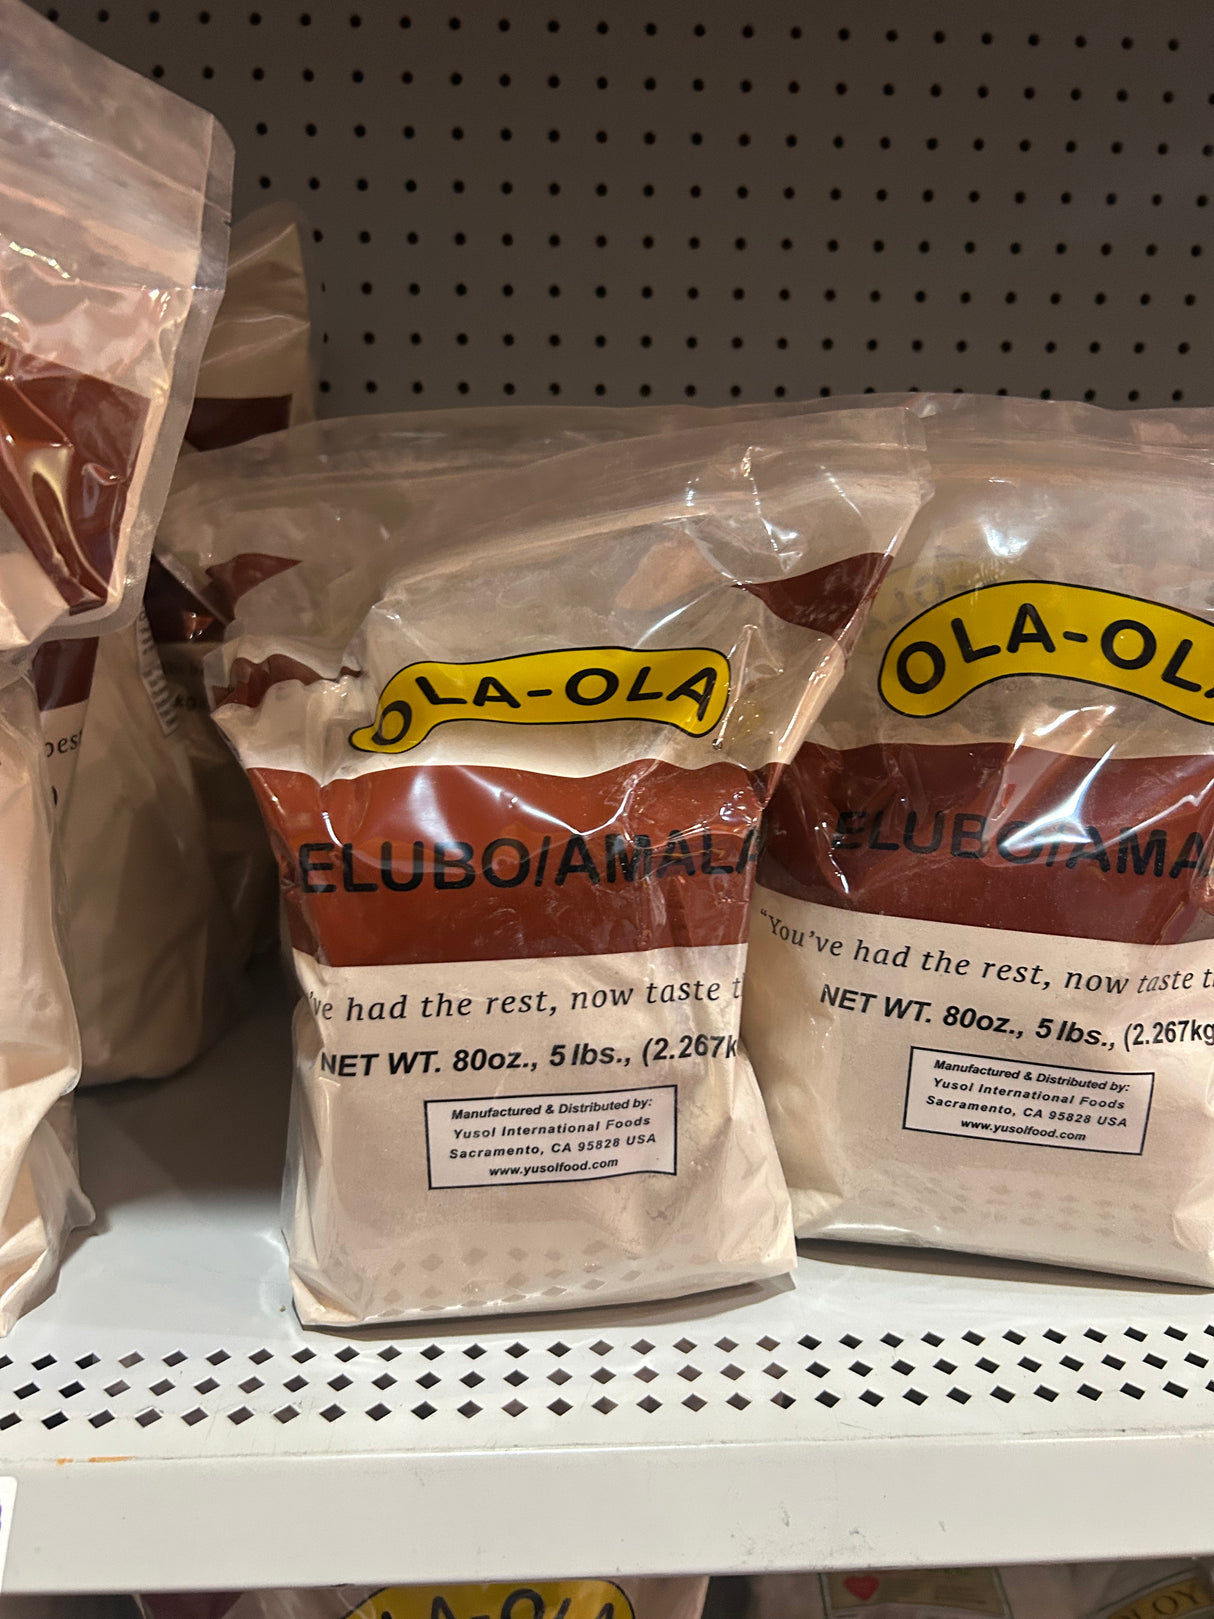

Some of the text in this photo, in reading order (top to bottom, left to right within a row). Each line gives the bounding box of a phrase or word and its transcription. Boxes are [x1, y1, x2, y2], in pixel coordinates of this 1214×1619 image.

[897, 603, 1214, 698] OLA-OL
[372, 666, 719, 745] OLA-OLA
[853, 939, 911, 969] had
[921, 950, 971, 976] the
[981, 959, 1051, 990] rest,
[1064, 972, 1130, 994] now
[1137, 969, 1194, 994] taste
[1203, 968, 1214, 988] t
[346, 994, 407, 1021] had
[421, 993, 472, 1017] the
[486, 989, 558, 1016] rest,
[571, 986, 634, 1010] now
[646, 980, 720, 1003] taste
[732, 973, 745, 998] t
[819, 984, 877, 1013] NET
[883, 996, 933, 1023] WT.
[942, 1005, 1024, 1039] 80oz.,
[1124, 1019, 1214, 1052] (2.267kg
[320, 1051, 379, 1076] NET
[389, 1051, 441, 1074] WT.
[453, 1046, 538, 1073] 80oz.,
[642, 1034, 737, 1067] (2.267k
[933, 1059, 1131, 1095] Manufactured & Distributed by:
[933, 1077, 1126, 1110] Yusol International Foods
[451, 1095, 653, 1121] Manufactured & Distributed by:
[926, 1095, 1128, 1129] Sacramento, CA 95828 USA
[453, 1114, 651, 1140] Yusol International Foods
[960, 1118, 1087, 1142] www.yusolfood.com
[449, 1133, 656, 1160] Sacramento, CA 95828 USA
[489, 1156, 619, 1177] www.yusolfood.com
